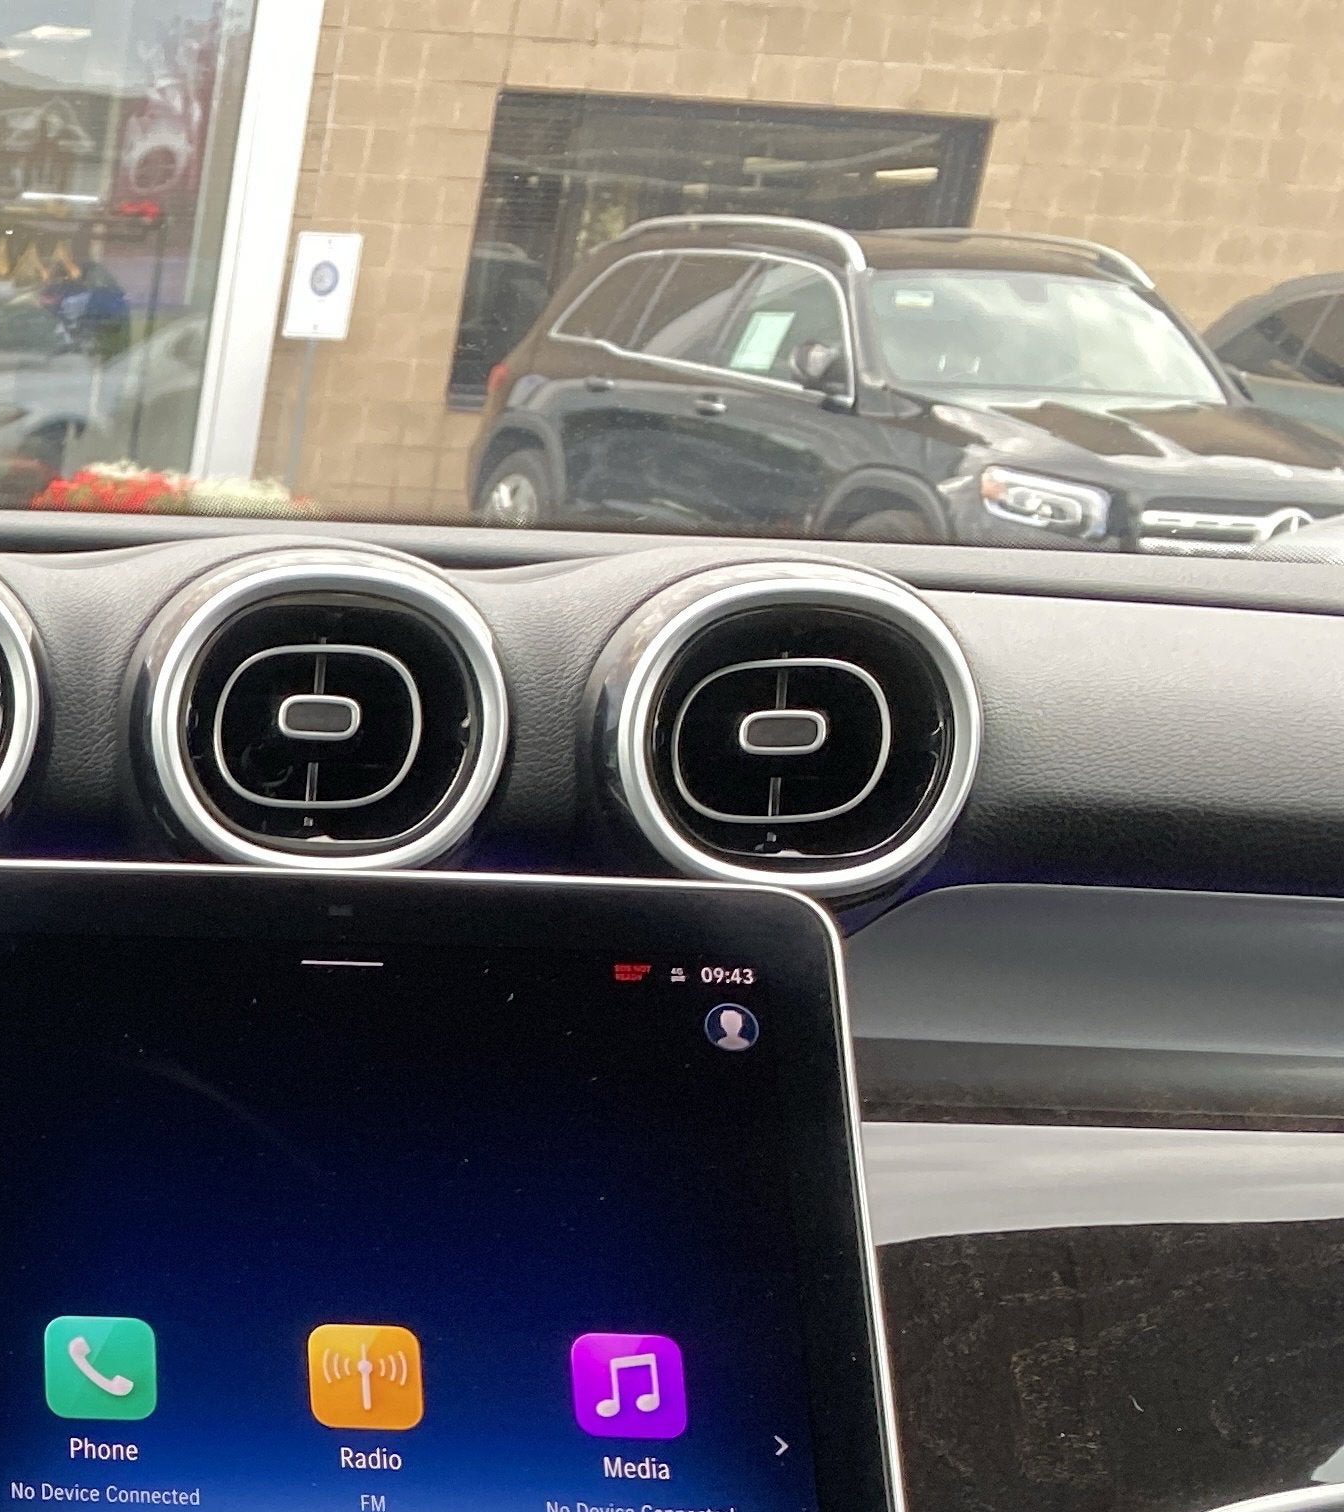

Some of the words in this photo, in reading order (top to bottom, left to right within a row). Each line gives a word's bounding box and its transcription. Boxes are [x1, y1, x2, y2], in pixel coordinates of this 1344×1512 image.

[701, 966, 755, 985] 09:43
[69, 1437, 139, 1461] Phone
[340, 1446, 403, 1470] Radio
[603, 1456, 671, 1480] Media
[11, 1482, 36, 1500] No
[41, 1483, 100, 1502] Device
[105, 1485, 201, 1506] Connected
[360, 1494, 386, 1512] FM
